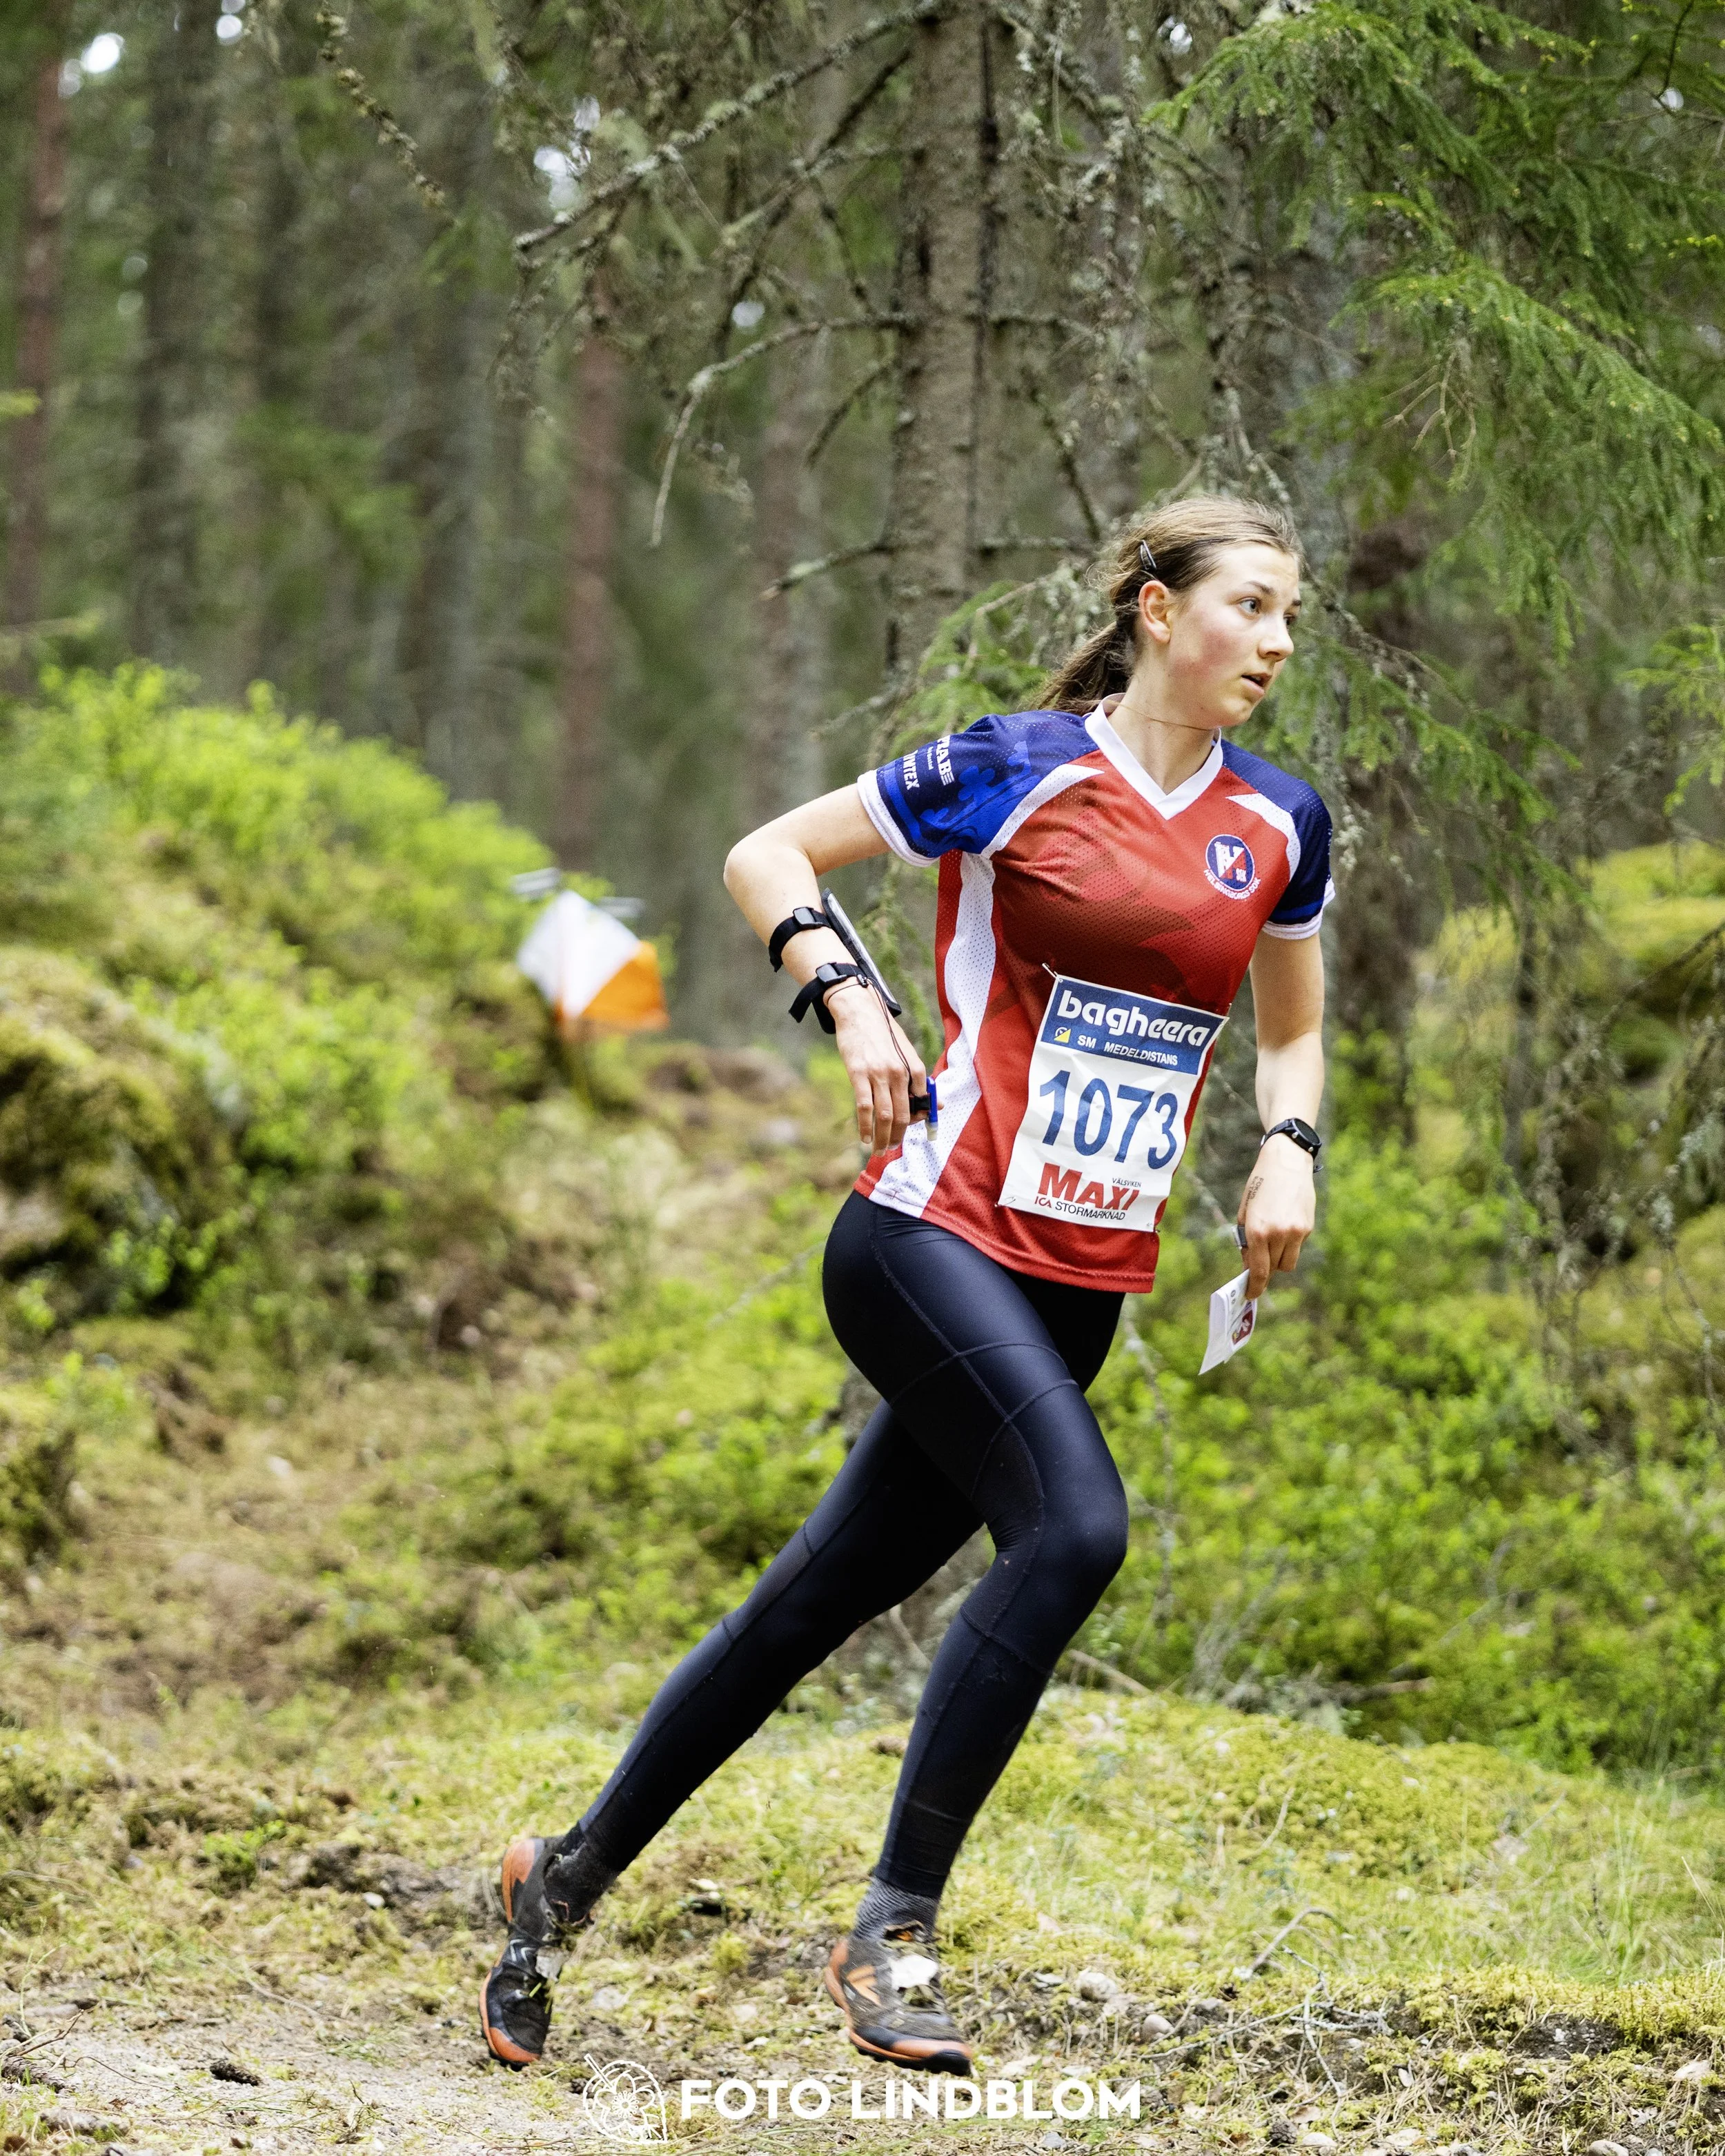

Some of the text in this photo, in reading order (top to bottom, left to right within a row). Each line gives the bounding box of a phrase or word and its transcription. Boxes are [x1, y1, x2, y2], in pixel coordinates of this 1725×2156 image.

[1248, 877, 1261, 893] SOK
[1056, 990, 1210, 1047] bagheera
[1077, 1035, 1178, 1066] SM MEDELDISTANS
[1040, 1070, 1179, 1169] 1073
[1038, 1162, 1140, 1211] MAXI
[1112, 1178, 1142, 1187] VÄLSVIKEN
[1034, 1196, 1125, 1220] ICA STORMARKNAD
